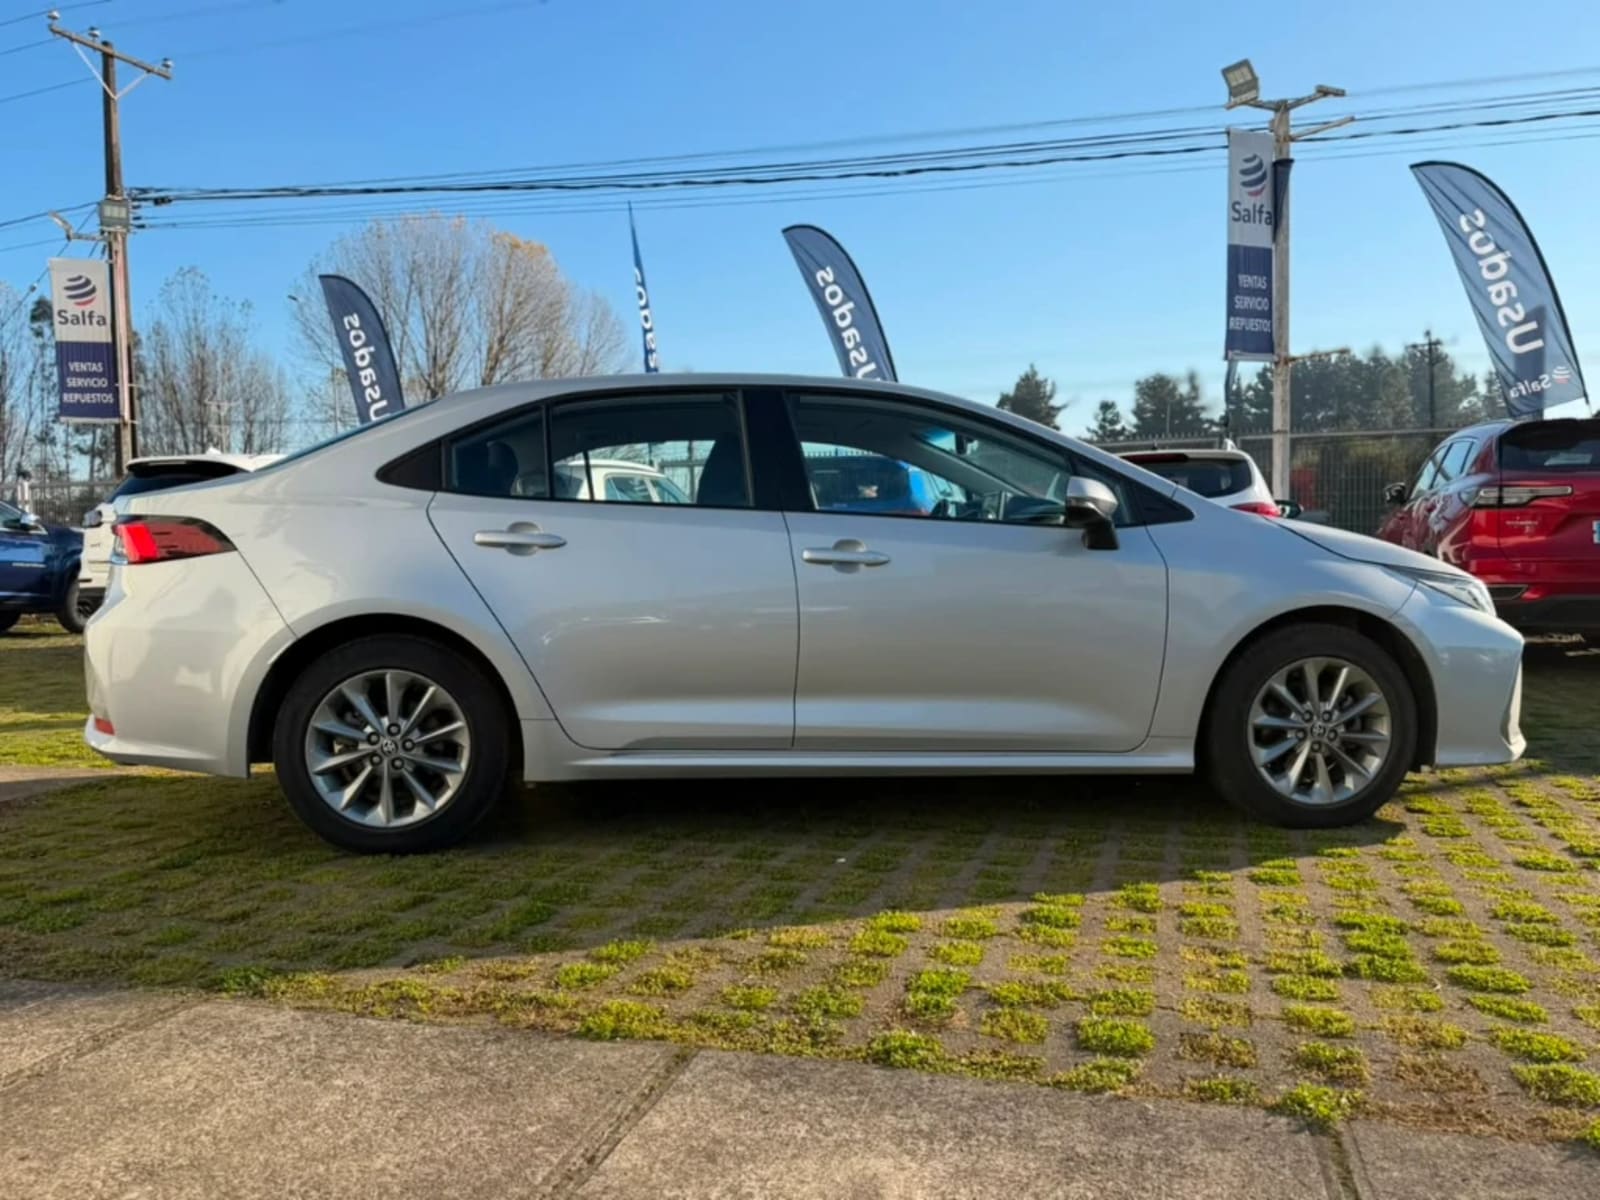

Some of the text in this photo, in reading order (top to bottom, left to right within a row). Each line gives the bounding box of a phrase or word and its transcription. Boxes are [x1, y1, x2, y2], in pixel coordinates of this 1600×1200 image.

[1231, 202, 1272, 226] Salfa
[1238, 273, 1267, 290] VENTAS
[1234, 295, 1269, 311] SERVICIO
[57, 309, 107, 327] Salfa
[68, 361, 103, 373] VENTAS
[66, 377, 108, 389] SERVICIO
[62, 392, 114, 404] REPUESTOS
